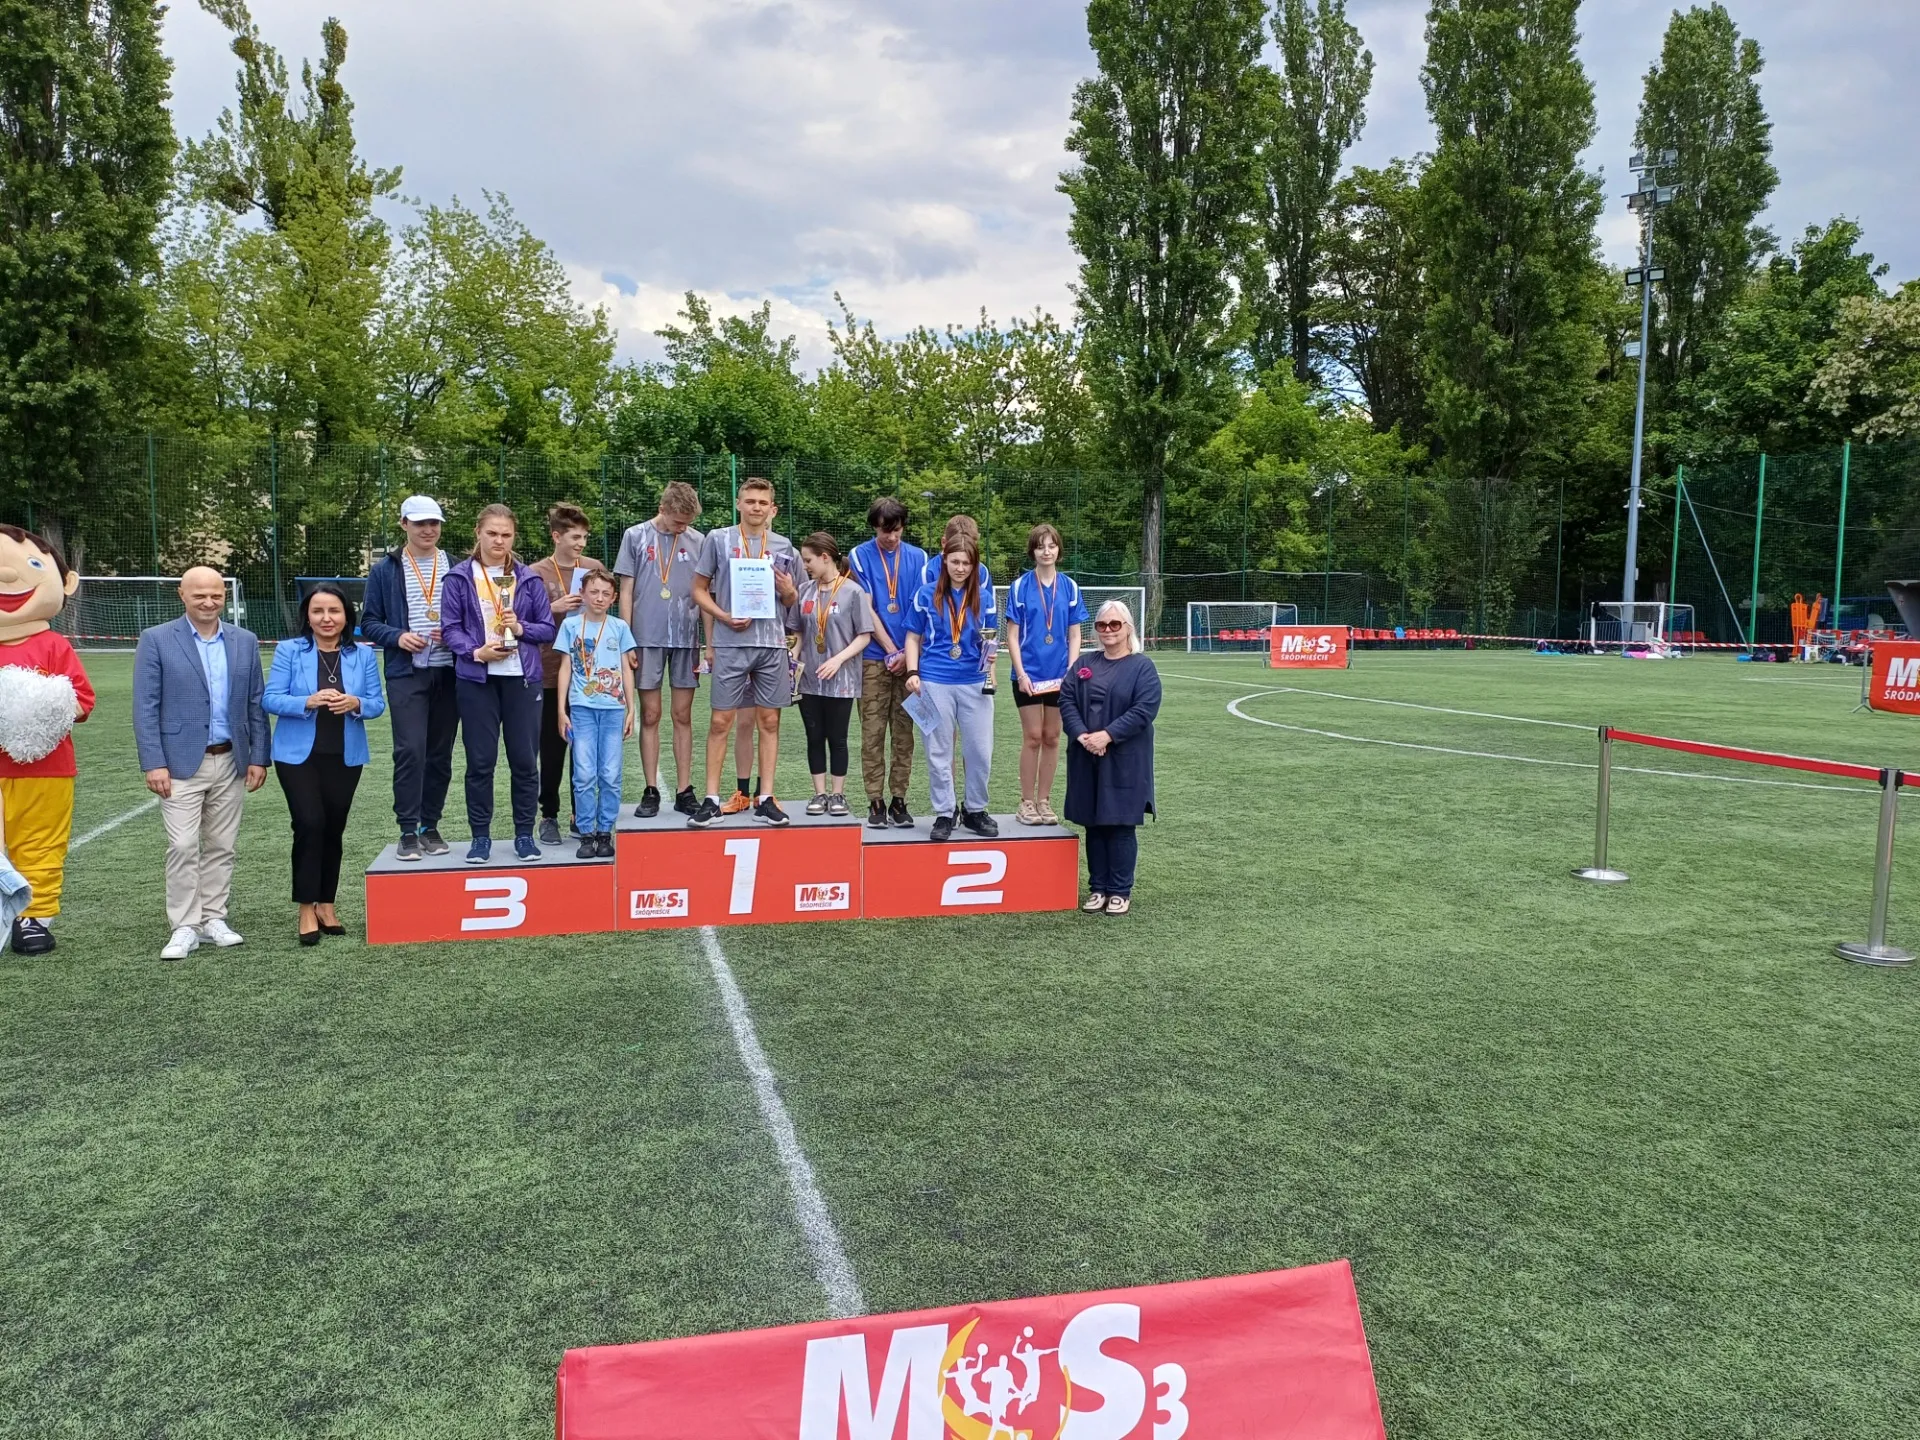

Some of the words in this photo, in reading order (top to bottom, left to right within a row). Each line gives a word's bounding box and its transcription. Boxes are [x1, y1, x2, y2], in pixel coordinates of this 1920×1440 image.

[1281, 653, 1329, 661] ŚRÓDMIEŚCIE
[1885, 657, 1920, 687] M
[460, 876, 528, 932] 3
[723, 838, 760, 915] 1
[940, 850, 1007, 906] 2
